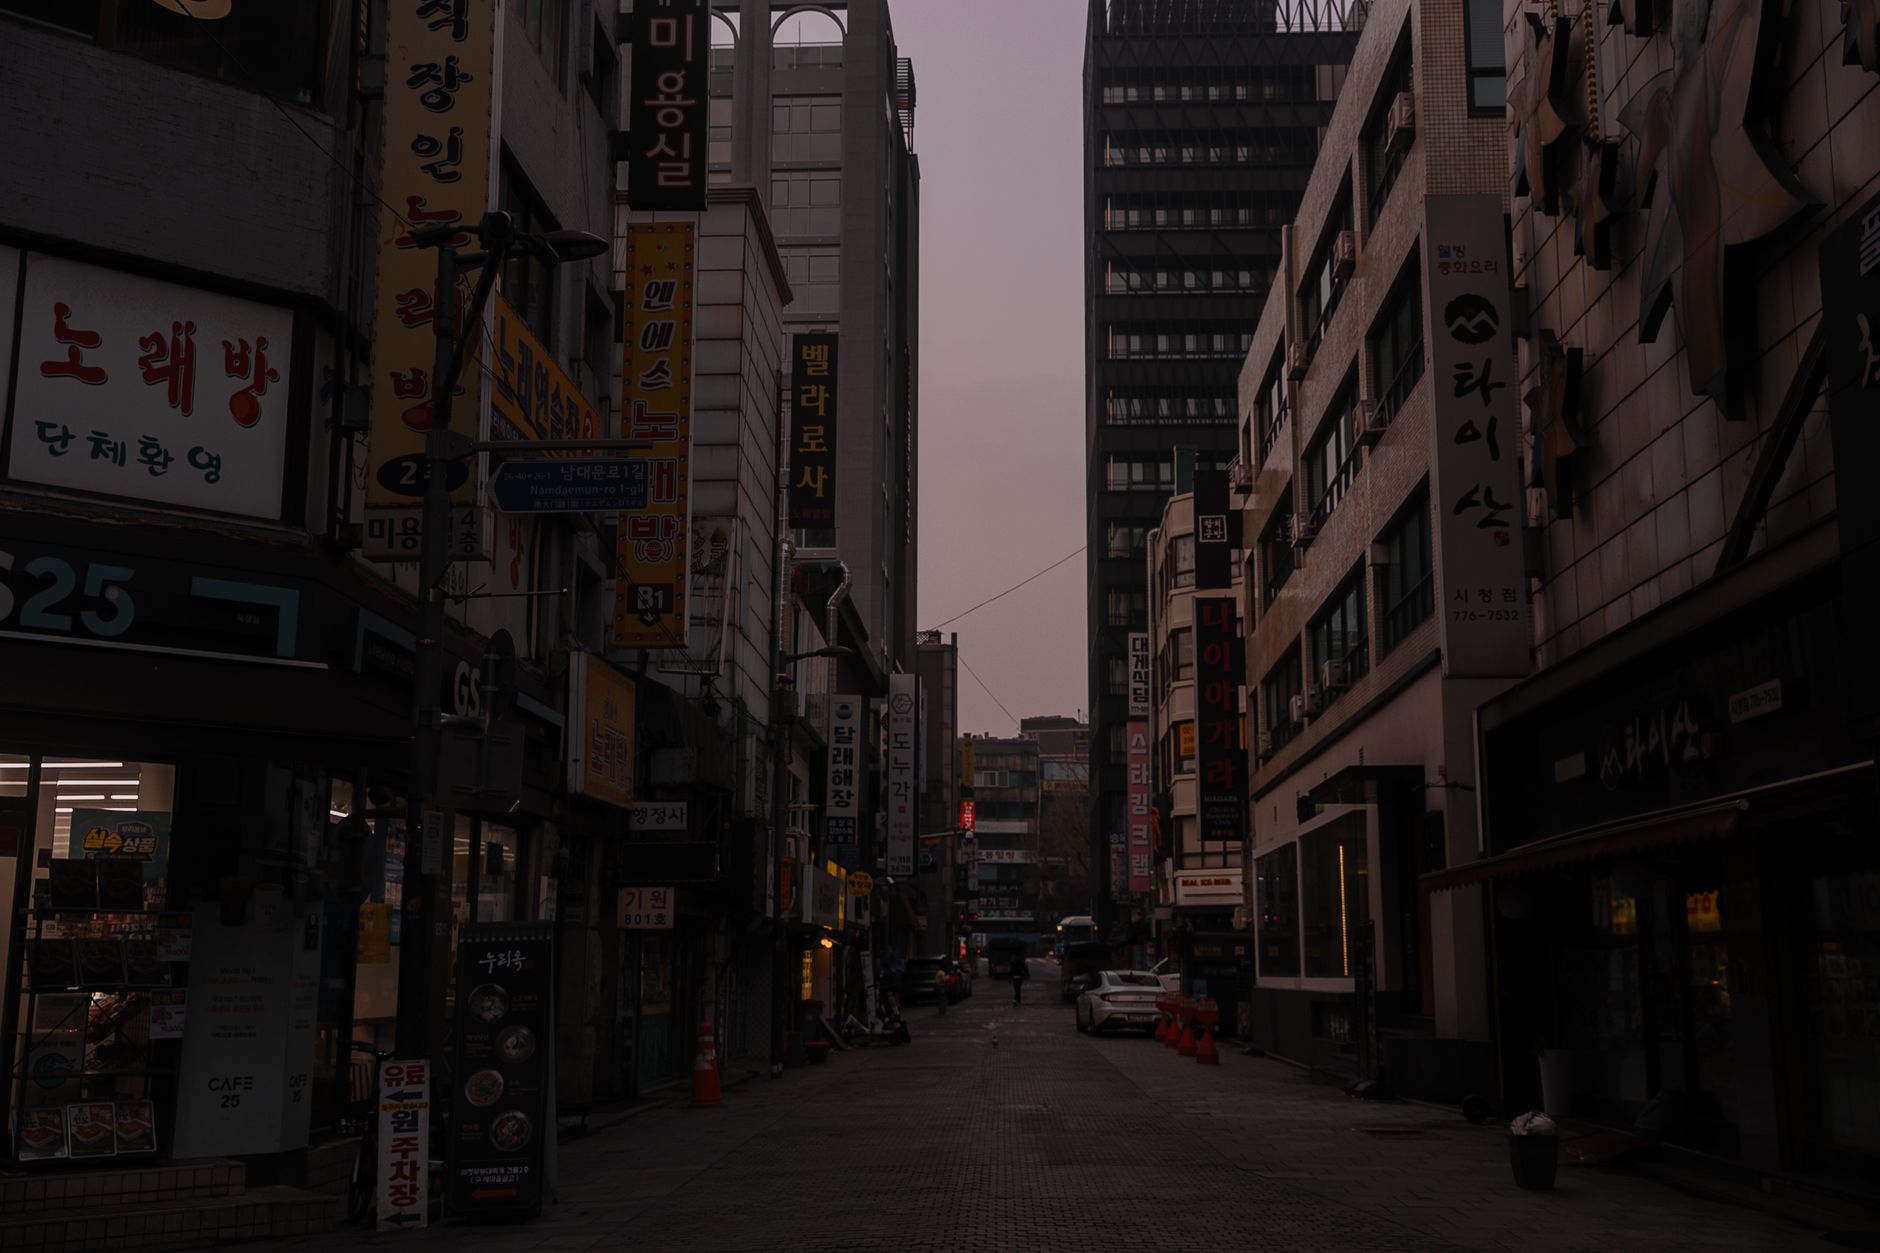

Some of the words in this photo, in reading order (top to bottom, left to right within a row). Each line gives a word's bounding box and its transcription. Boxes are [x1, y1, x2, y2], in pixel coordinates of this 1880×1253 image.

[1438, 260, 1498, 276] 중화요리
[40, 302, 280, 428] 노래방
[795, 343, 831, 498] 벨라로사
[1453, 357, 1514, 529] 타이산
[560, 463, 645, 481] 남대문로1길
[530, 484, 617, 496] Namdaemun-ro
[459, 509, 479, 553] 4층
[1454, 588, 1517, 604] 시청점
[1453, 609, 1519, 621] 776-7532
[453, 660, 481, 720] GS
[1201, 602, 1236, 790] 나이아가라
[831, 726, 856, 809] 달래해장
[891, 732, 911, 803] 도누각
[631, 806, 685, 823] 행정사
[1130, 733, 1150, 877] 스타킹크랩
[624, 890, 668, 910] 기원
[624, 913, 666, 926] 801호
[208, 1076, 253, 1091] CAFE
[384, 1064, 425, 1088] 유료
[220, 1094, 241, 1109] 25
